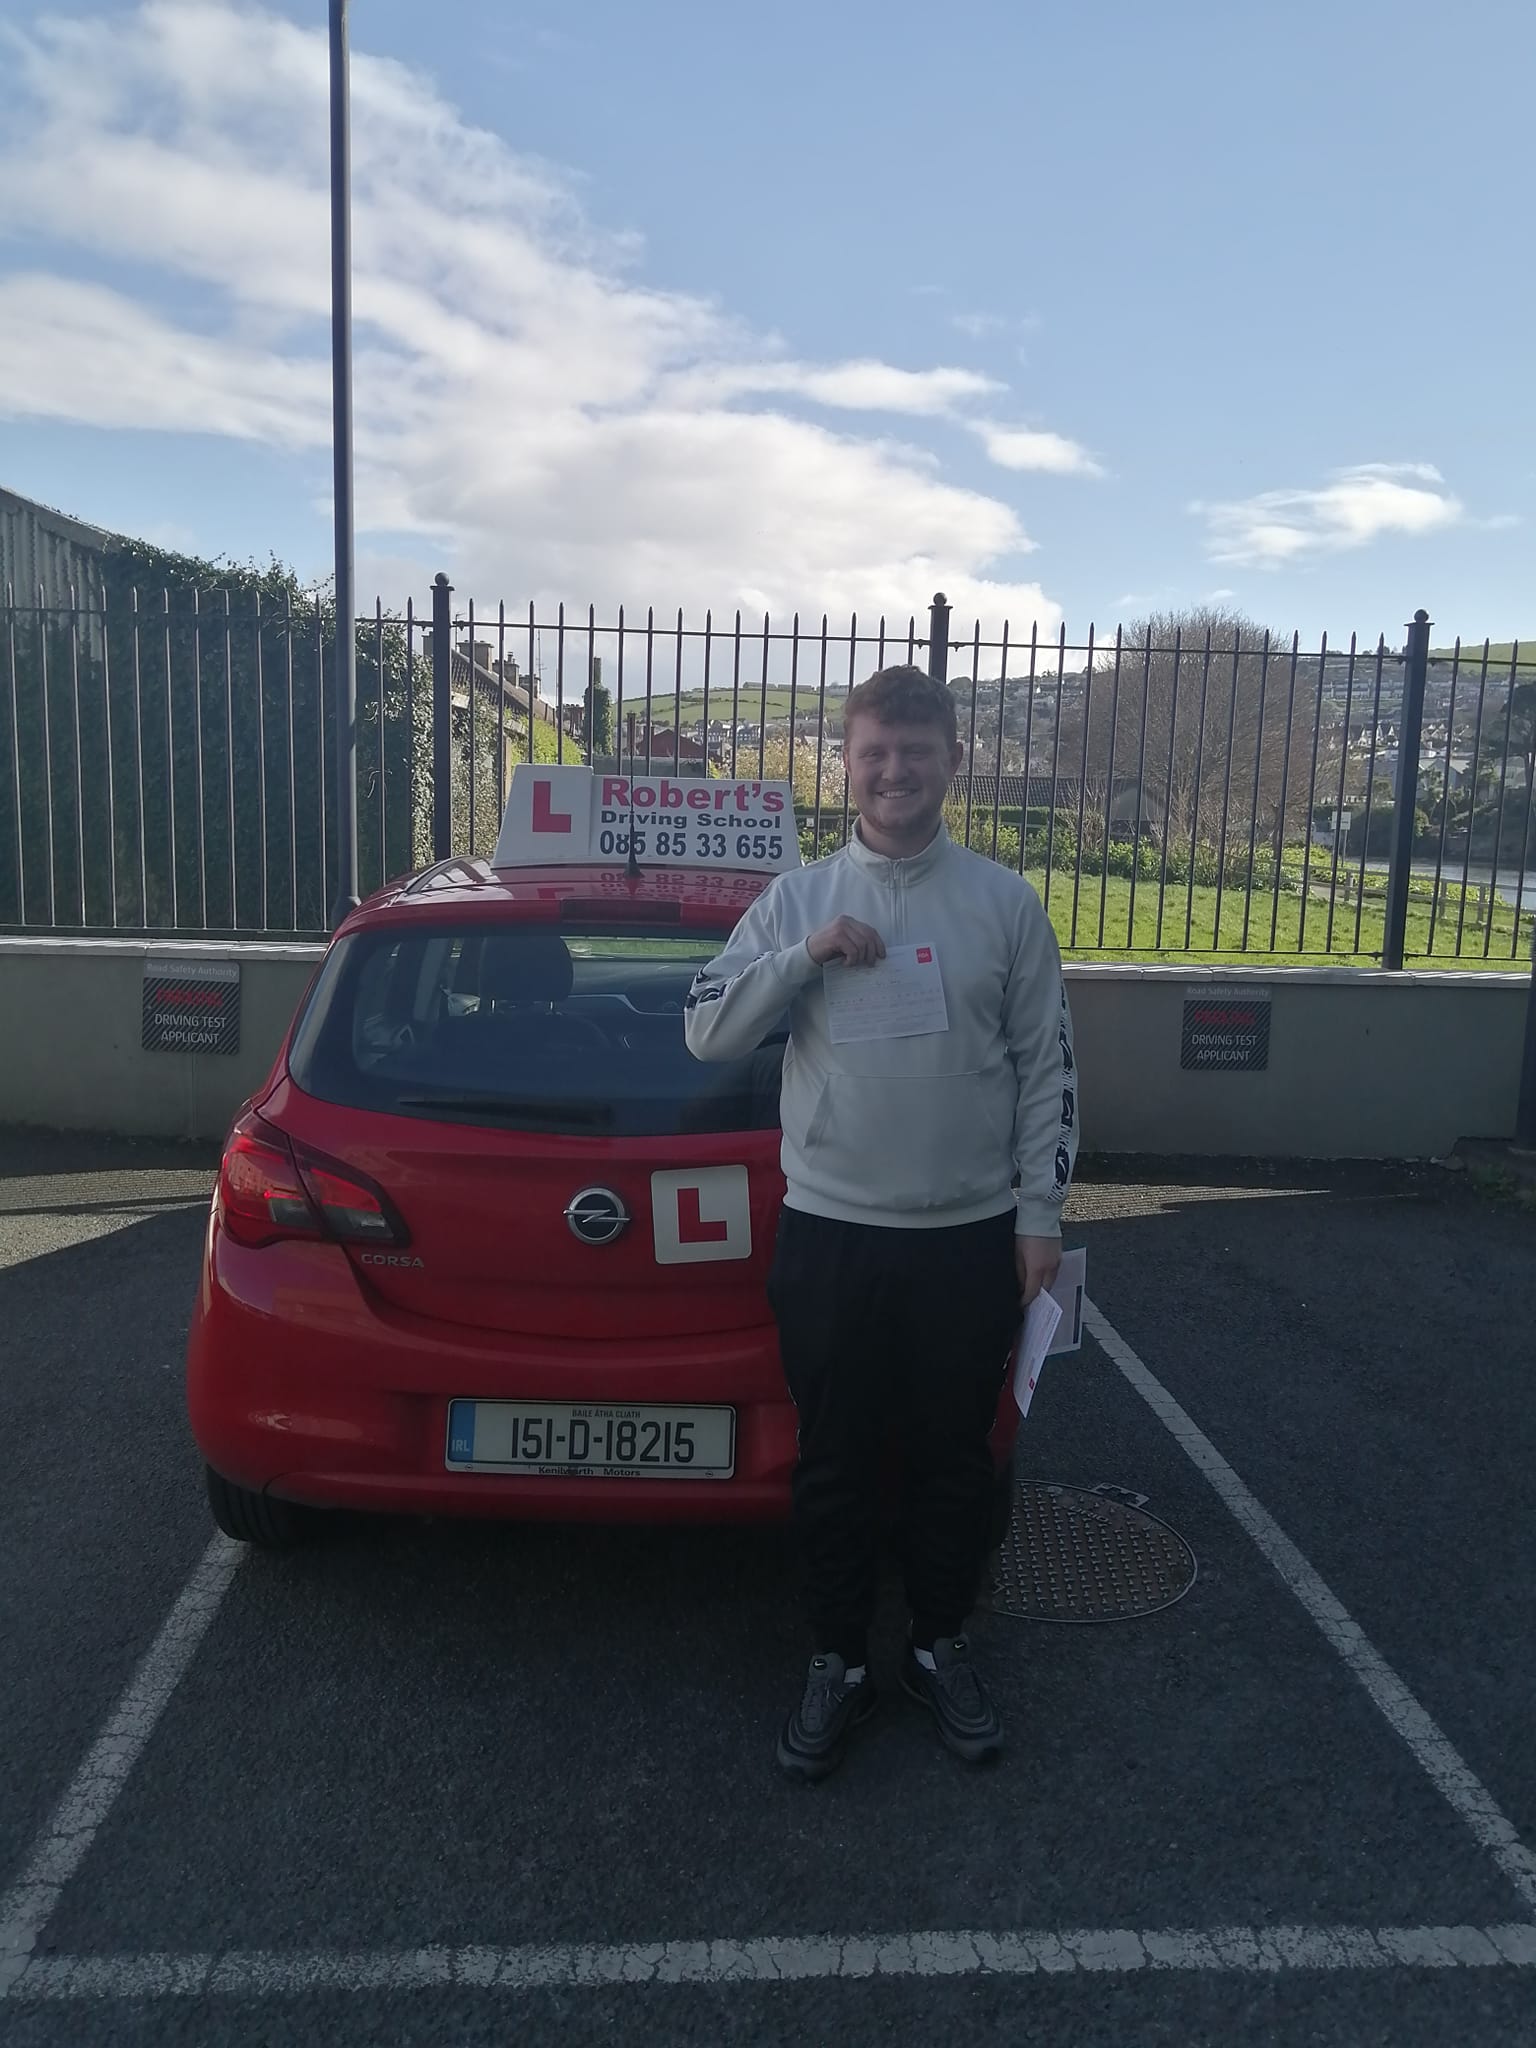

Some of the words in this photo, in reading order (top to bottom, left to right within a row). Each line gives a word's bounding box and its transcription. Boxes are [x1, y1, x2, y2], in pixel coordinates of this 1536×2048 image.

[602, 778, 784, 812] Robert's
[532, 780, 572, 833] L
[601, 811, 687, 829] Driving
[697, 813, 781, 829] School
[600, 830, 646, 855] 085
[656, 832, 686, 857] 85
[696, 833, 727, 857] 33
[736, 834, 783, 859] 655
[155, 1014, 199, 1027] DRIVING
[202, 1016, 227, 1028] TEST
[161, 1031, 220, 1044] APPLICANT
[1192, 1034, 1232, 1046] DRIVING
[1235, 1035, 1257, 1046] TEST
[1197, 1050, 1251, 1061] APPLICANT
[677, 1187, 728, 1243] L
[360, 1253, 425, 1268] CORSA
[572, 1408, 593, 1418] BAILE
[615, 1410, 641, 1419] CLIATH
[452, 1439, 471, 1452] IRL
[511, 1417, 695, 1463] 151-D-18215
[538, 1466, 594, 1476] Kenilwrth
[603, 1467, 641, 1476] Motors
